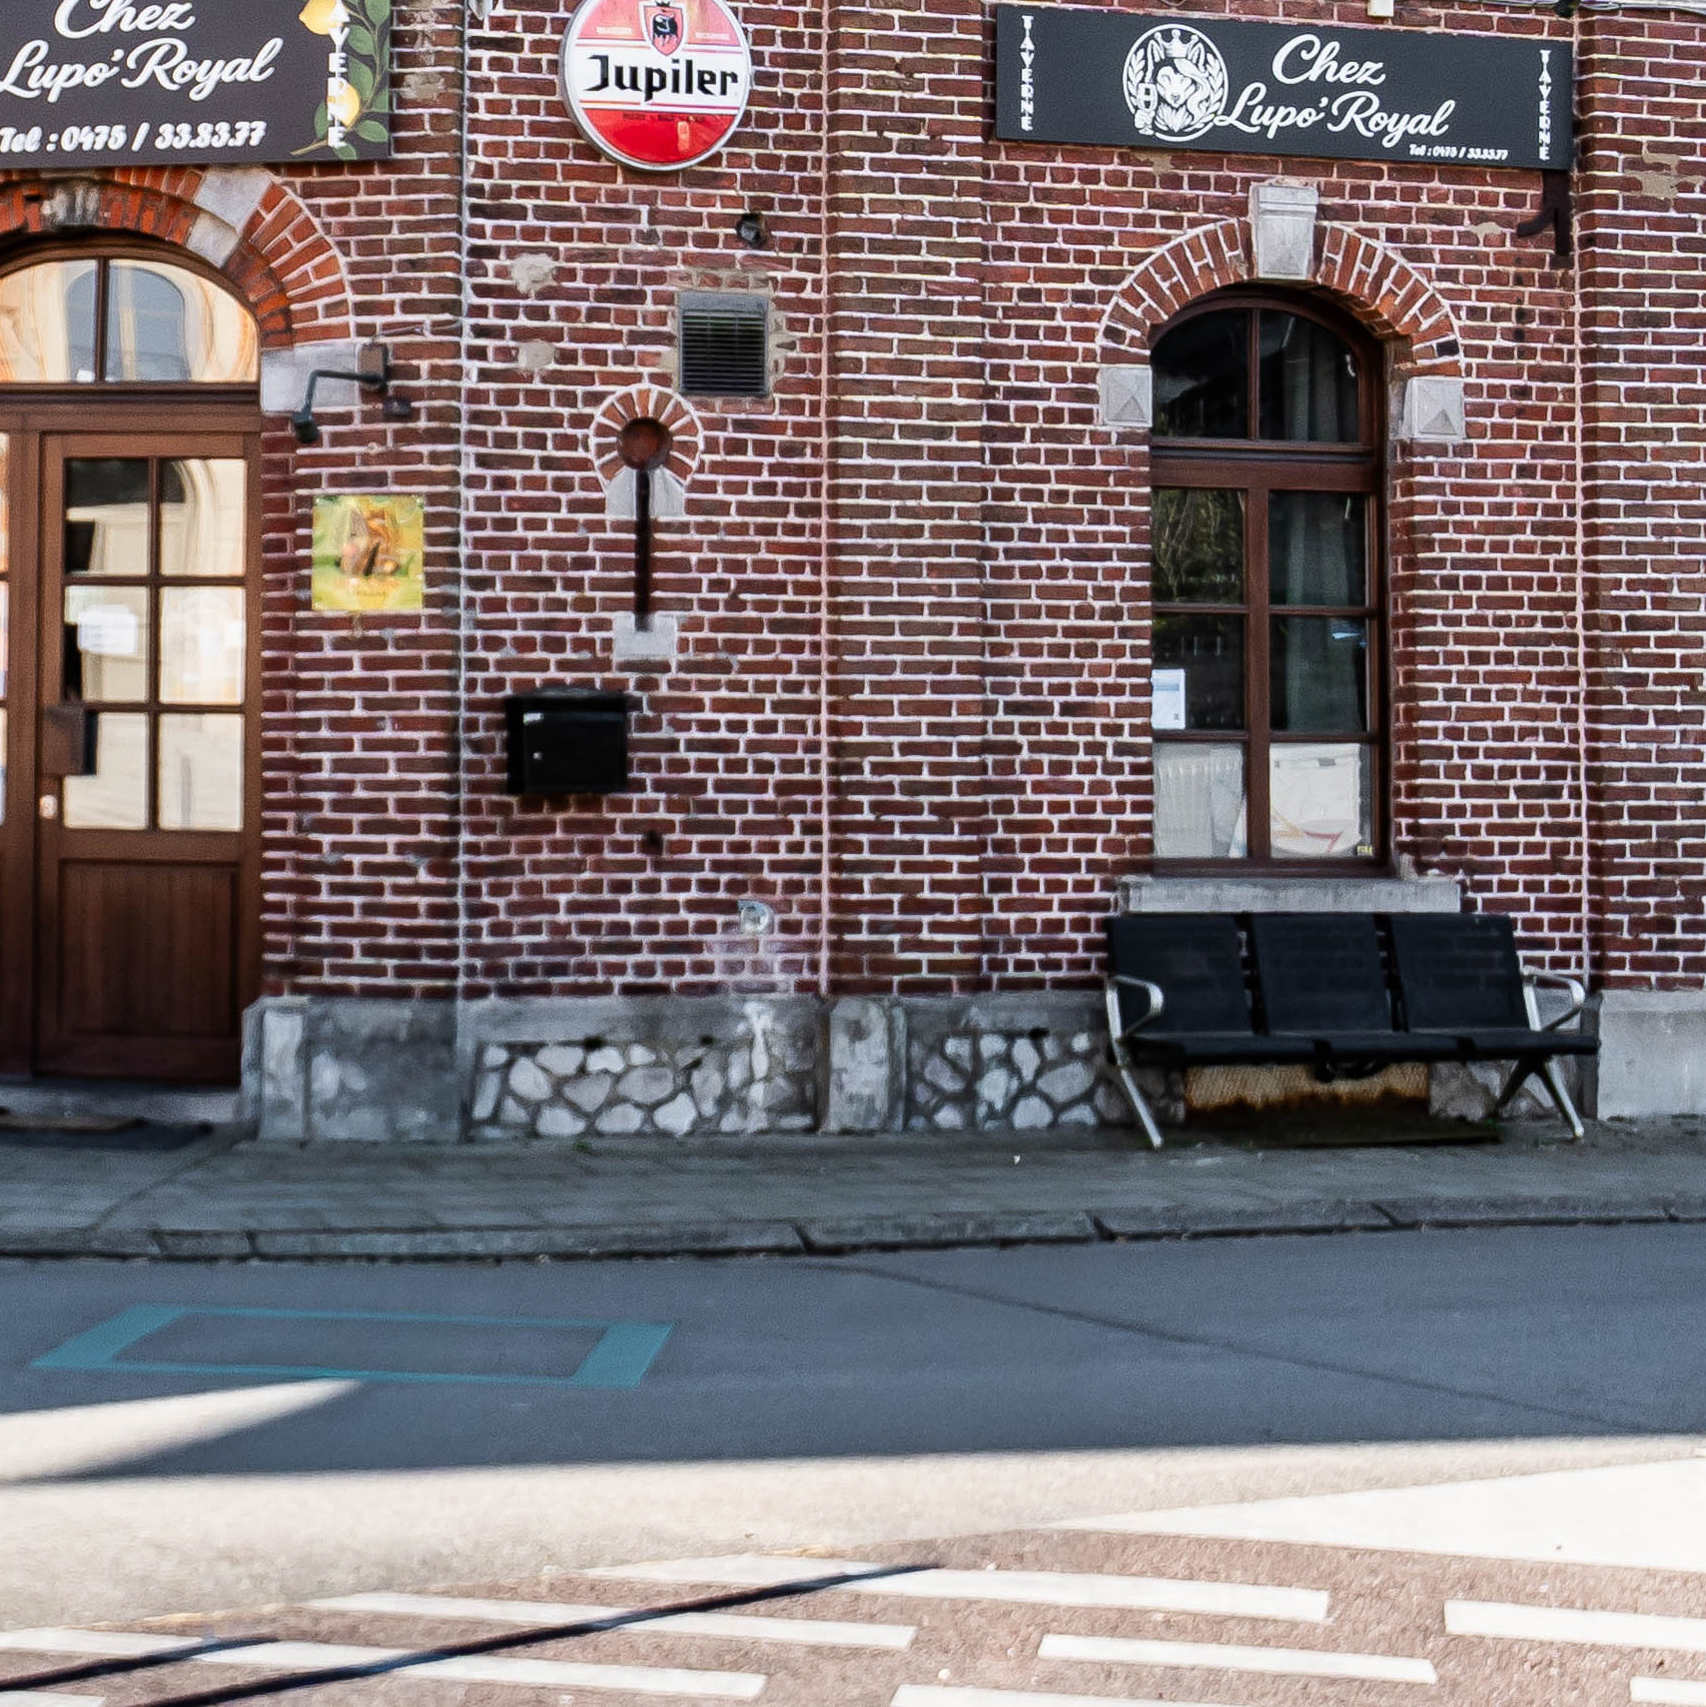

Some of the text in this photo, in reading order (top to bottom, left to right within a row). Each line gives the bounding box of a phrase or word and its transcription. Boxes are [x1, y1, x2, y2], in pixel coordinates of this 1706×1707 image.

[584, 53, 739, 103] Jupiler
[1020, 14, 1035, 132] TAVERNE
[1271, 33, 1387, 86] Chez
[1538, 49, 1553, 161] TAVERNE
[60, 124, 128, 152] 0475
